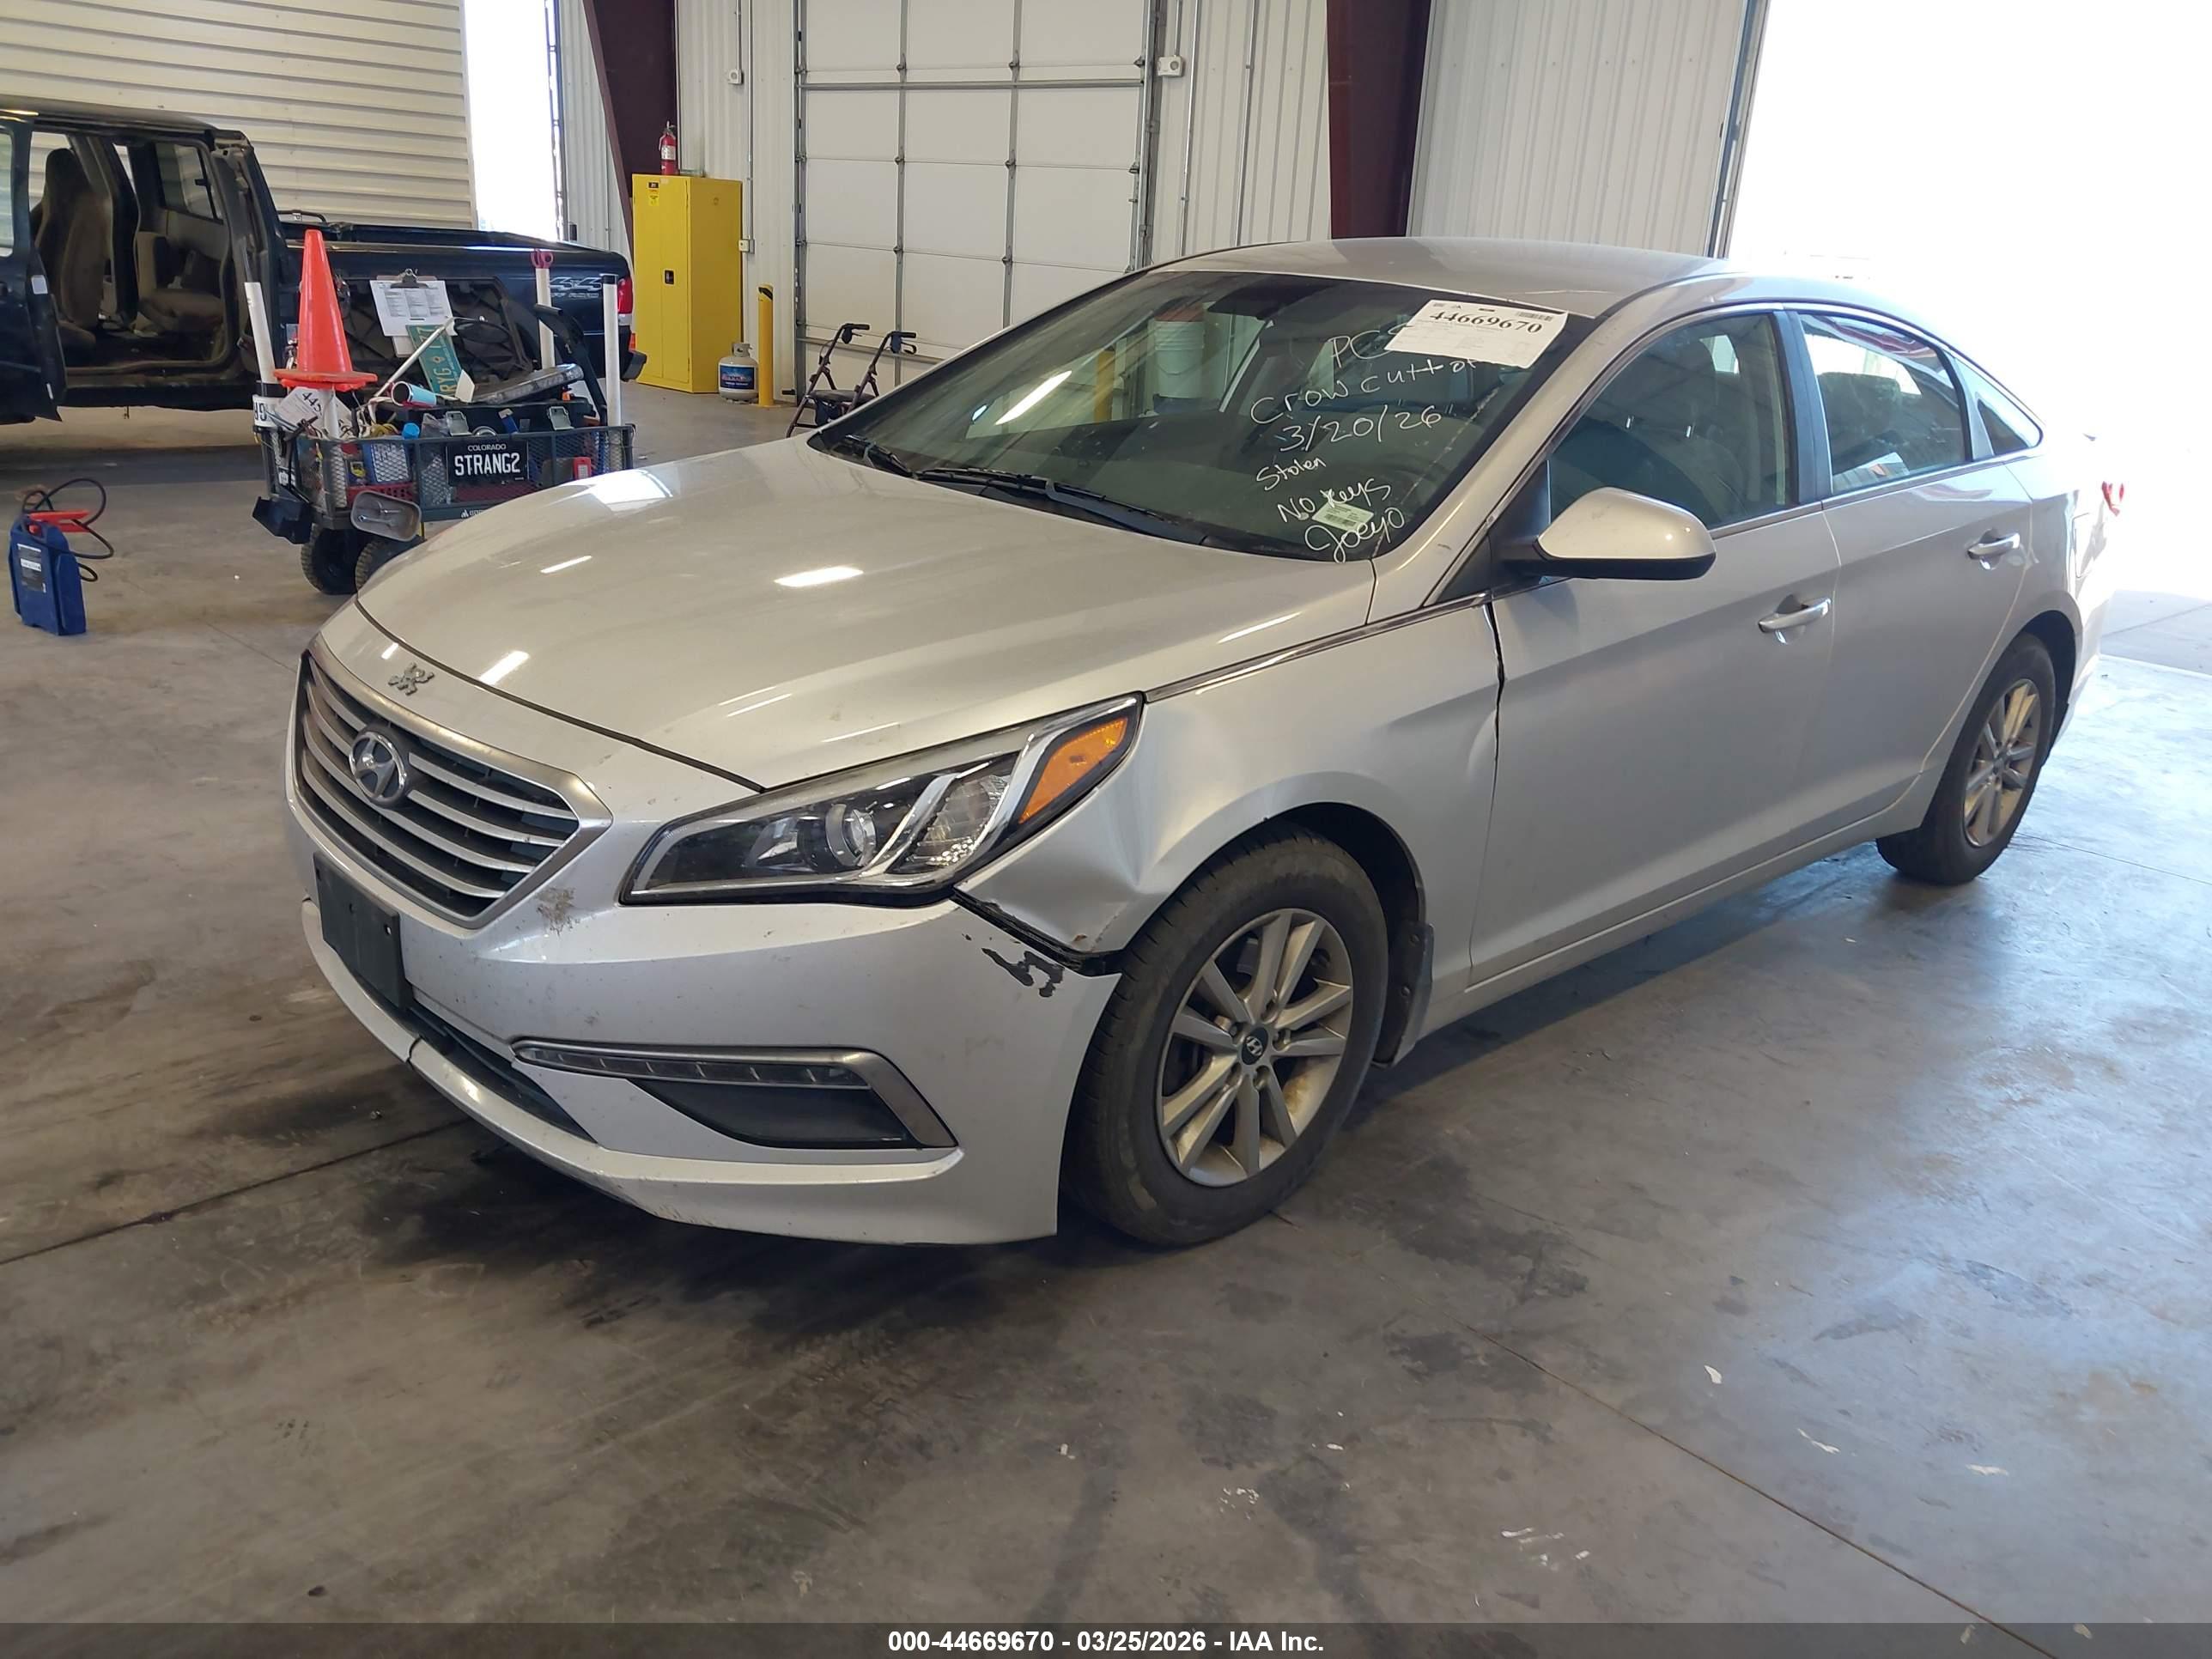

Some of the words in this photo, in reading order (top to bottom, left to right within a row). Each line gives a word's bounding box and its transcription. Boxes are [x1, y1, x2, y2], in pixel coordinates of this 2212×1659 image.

[1429, 311, 1543, 333] 44669670
[1279, 404, 1443, 452] 3/20/26
[467, 443, 507, 452] COLORADO
[454, 453, 521, 477] STRANG2
[1256, 457, 1327, 491] Stolen
